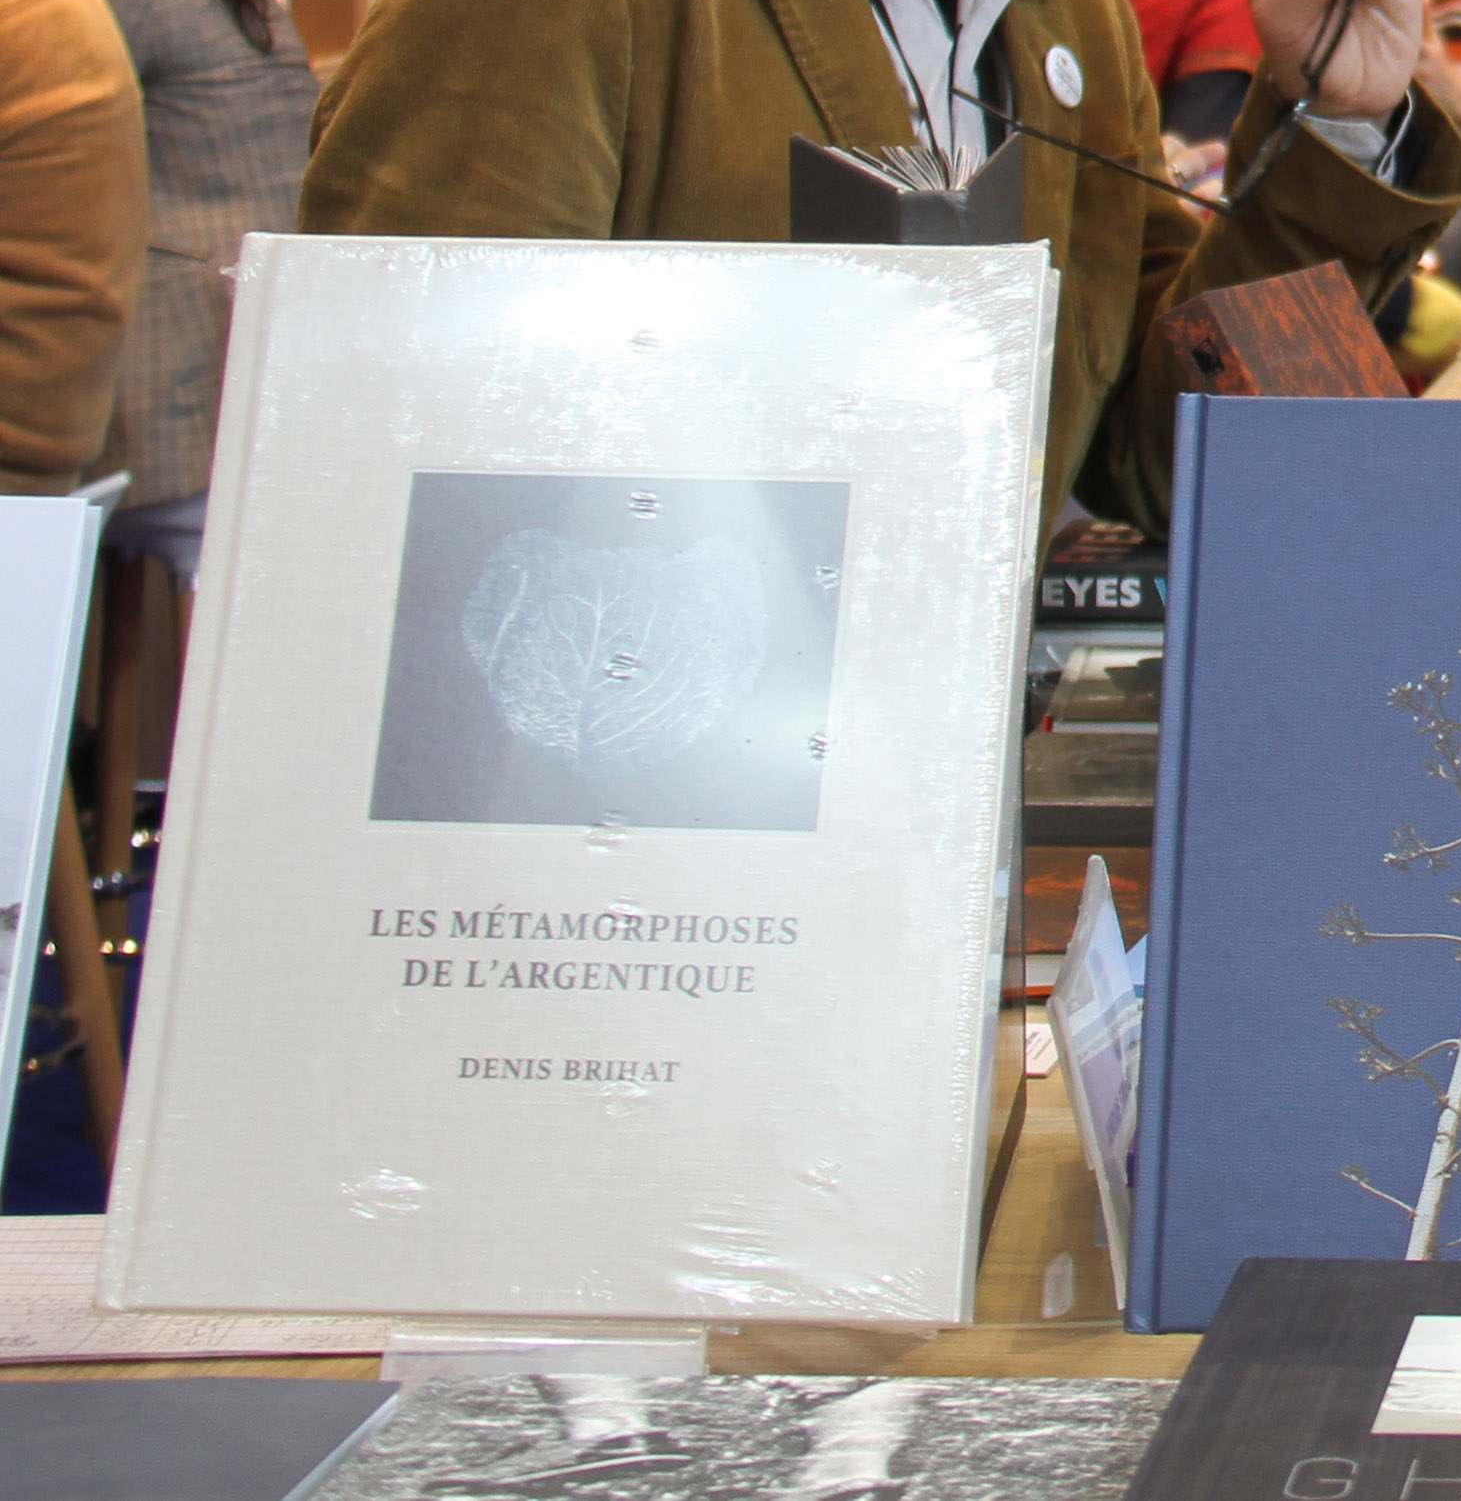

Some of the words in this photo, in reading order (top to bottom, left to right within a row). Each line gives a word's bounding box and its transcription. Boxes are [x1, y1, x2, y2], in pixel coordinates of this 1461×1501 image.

[1041, 578, 1141, 608] EYES
[370, 909, 437, 939] LES
[450, 904, 799, 945] MÉTAMORPHOSES
[402, 959, 454, 988] DE
[467, 960, 756, 999] L’ARGENTIQUE
[458, 1057, 552, 1081] DENIS
[563, 1059, 681, 1083] BRIHAT
